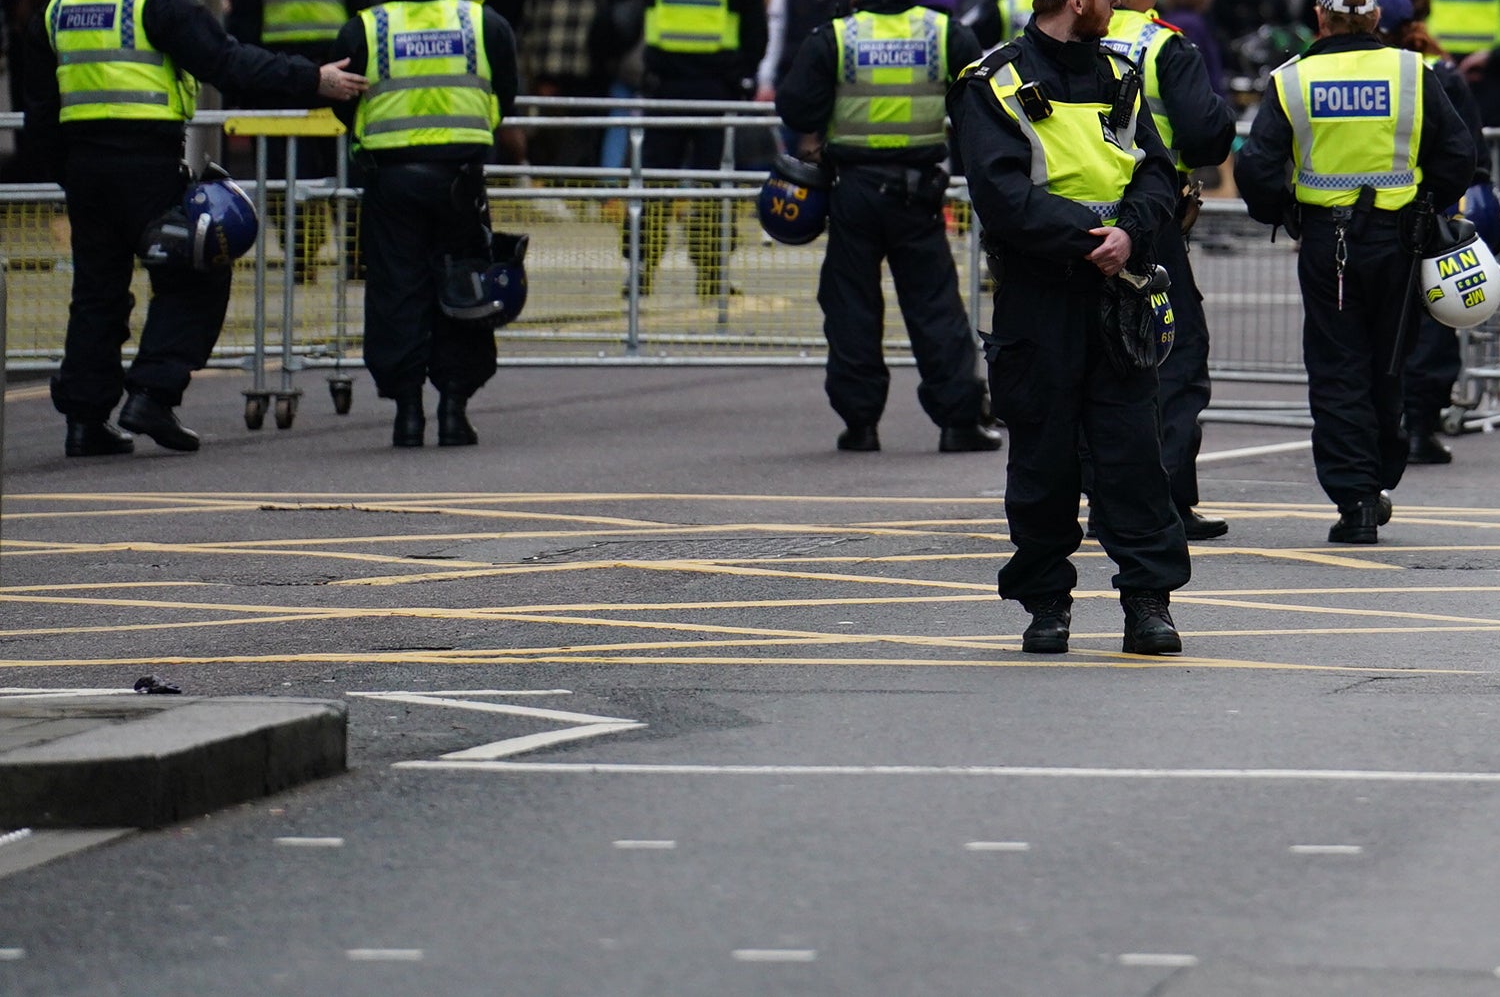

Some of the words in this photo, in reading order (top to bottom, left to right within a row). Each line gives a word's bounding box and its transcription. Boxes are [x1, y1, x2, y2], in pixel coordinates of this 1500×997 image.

[66, 13, 104, 27] POLICE
[406, 40, 453, 56] POLICE
[869, 50, 915, 64] POLICE
[1314, 86, 1387, 111] POLICE
[1465, 288, 1485, 307] MP
